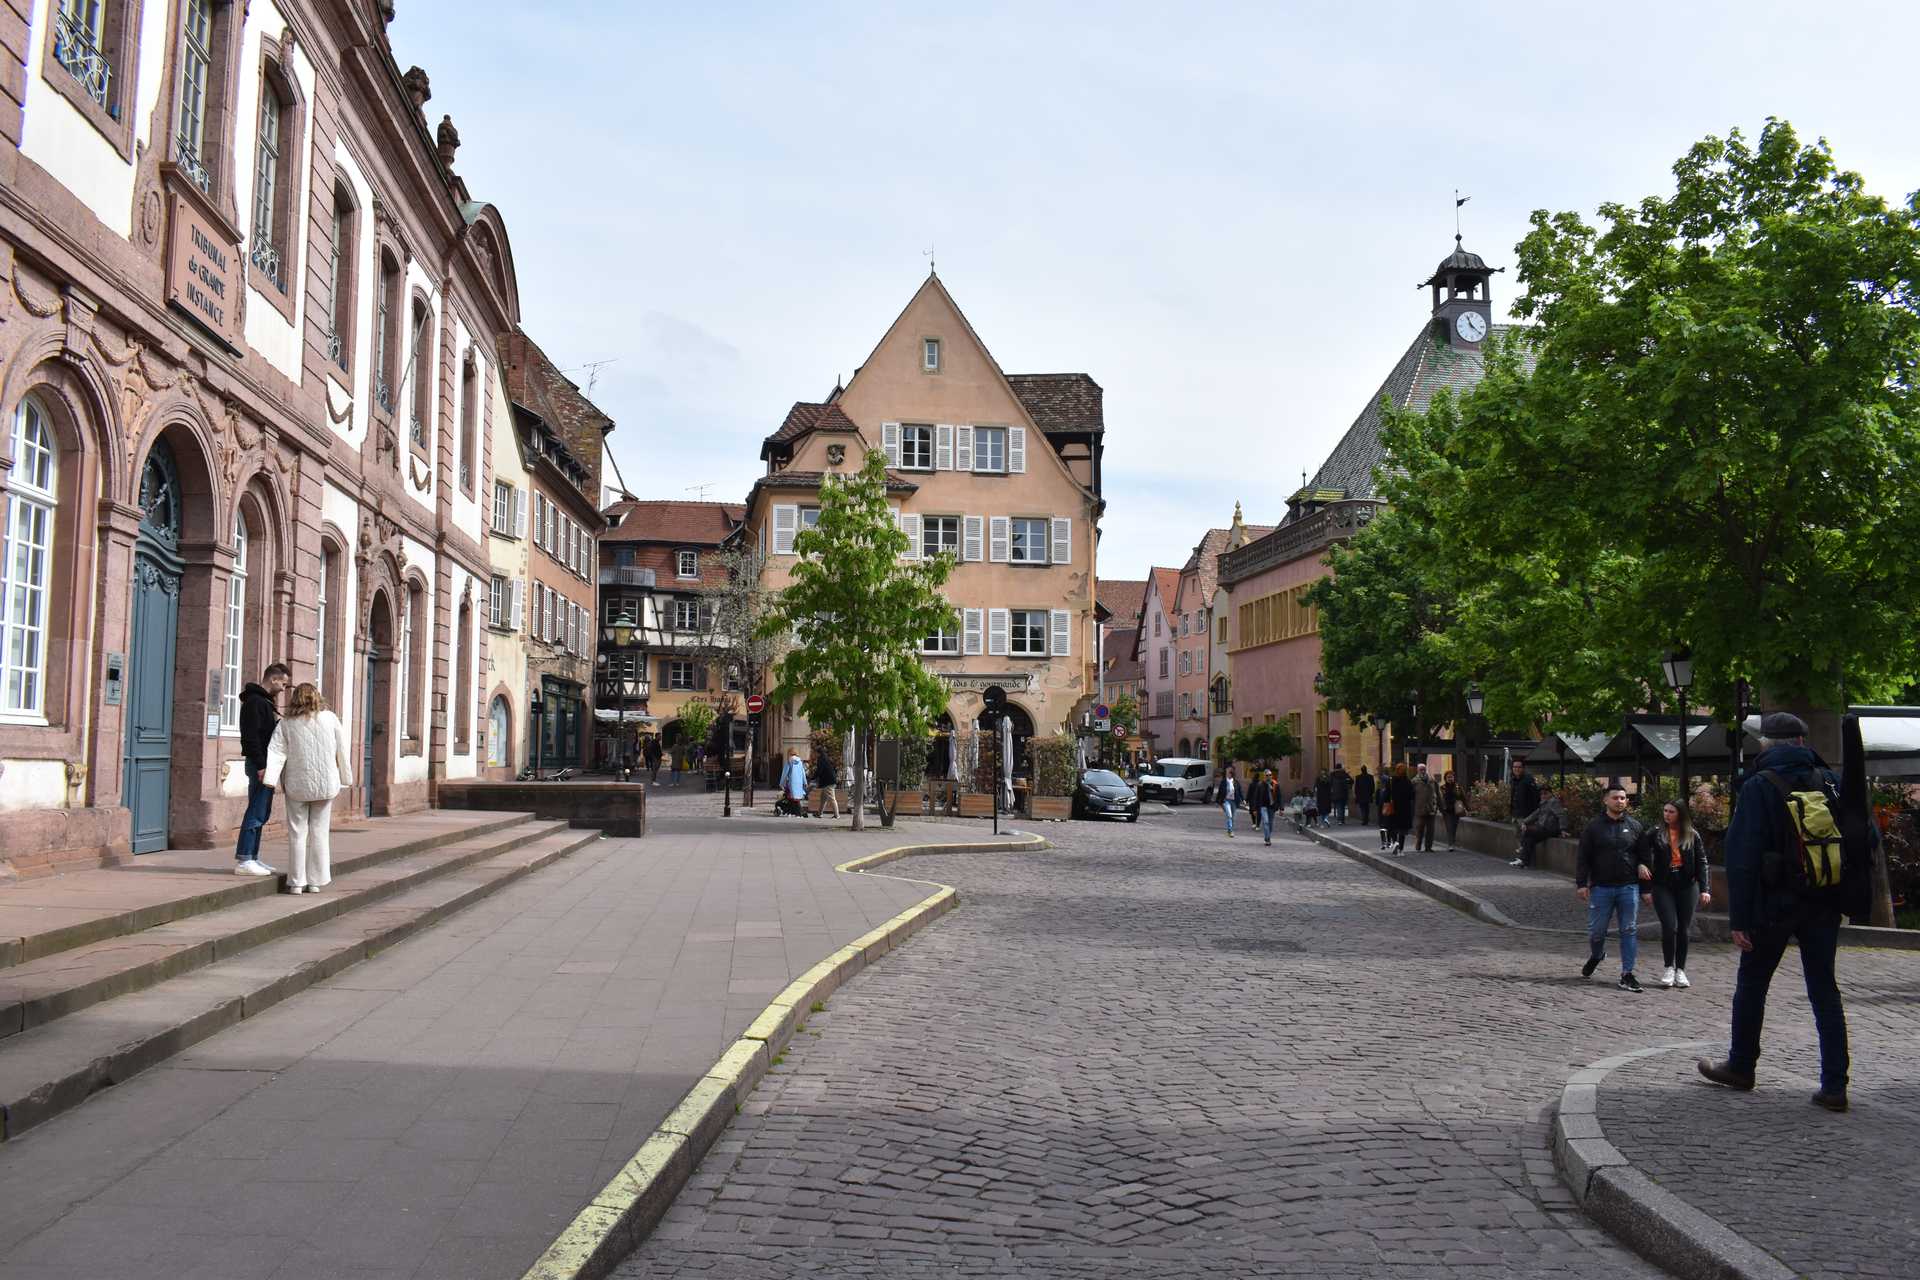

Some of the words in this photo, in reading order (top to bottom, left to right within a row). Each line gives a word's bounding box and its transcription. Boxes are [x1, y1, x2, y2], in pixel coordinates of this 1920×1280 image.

[191, 223, 226, 273] TRIBUNAL
[188, 254, 198, 274] de
[198, 265, 226, 300] GRANDE
[186, 281, 224, 327] INSTANCE
